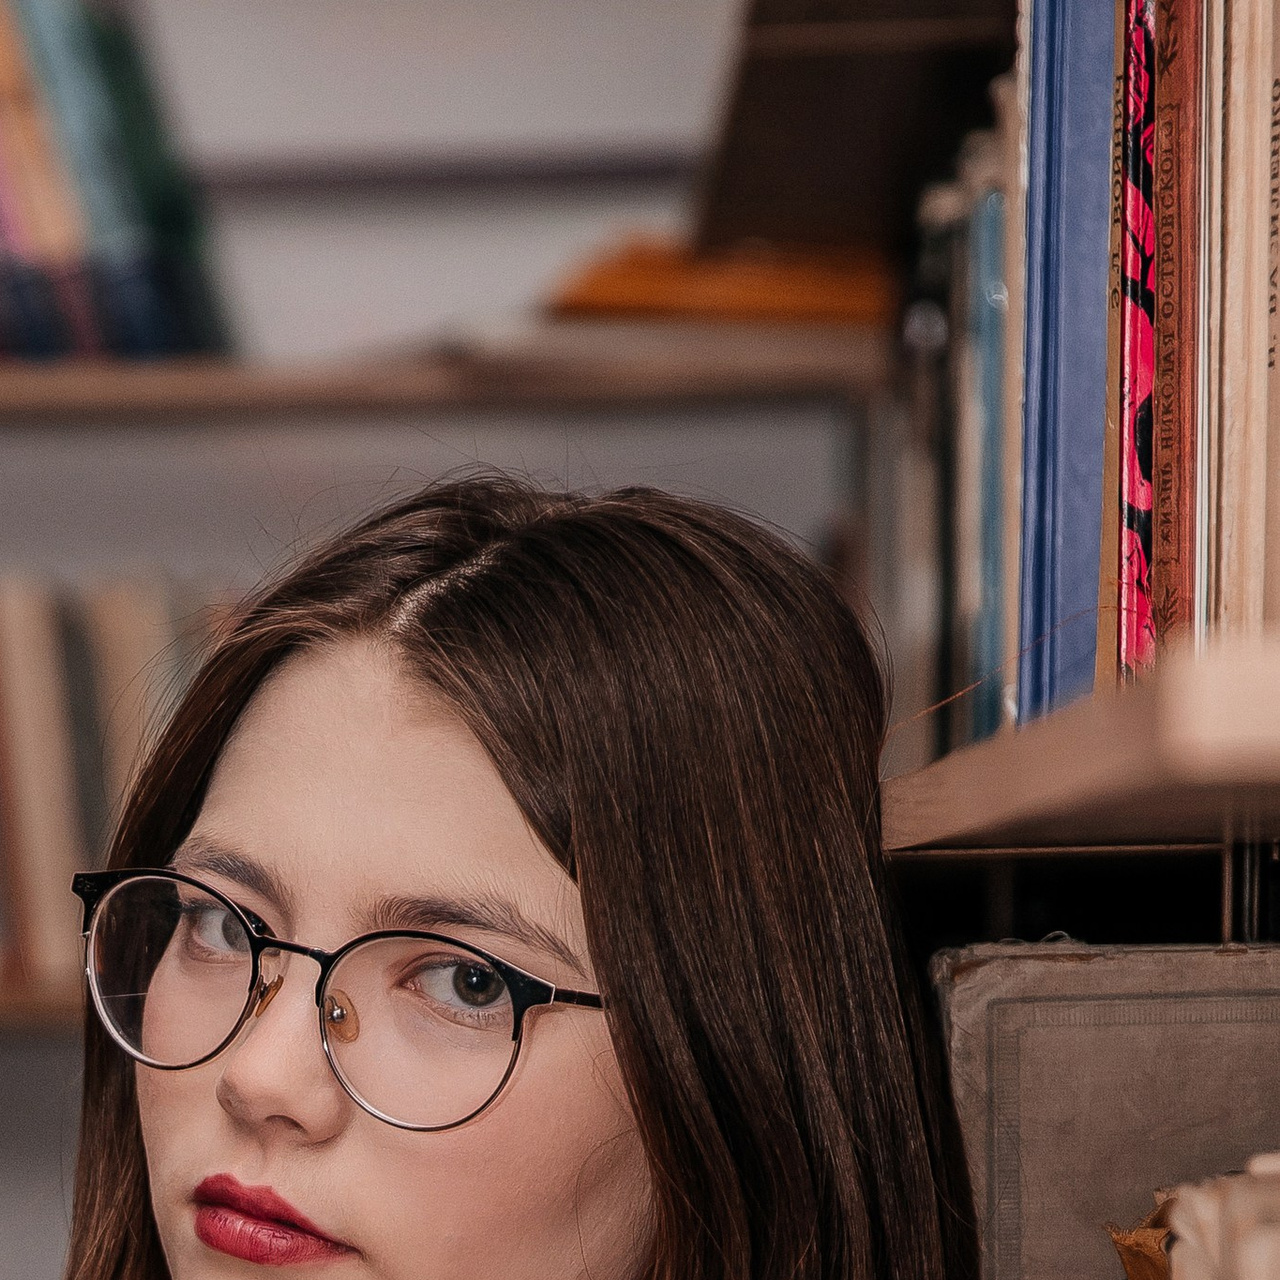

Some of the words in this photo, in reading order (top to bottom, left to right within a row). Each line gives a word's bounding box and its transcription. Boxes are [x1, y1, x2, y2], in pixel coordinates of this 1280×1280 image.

[1111, 75, 1124, 227] ВОЙНИЧ
[1159, 119, 1175, 319] ОСТРОВСКОГО
[1160, 331, 1175, 451] НИКОЛАЯ
[1160, 462, 1174, 543] ЖИЗНЬ
